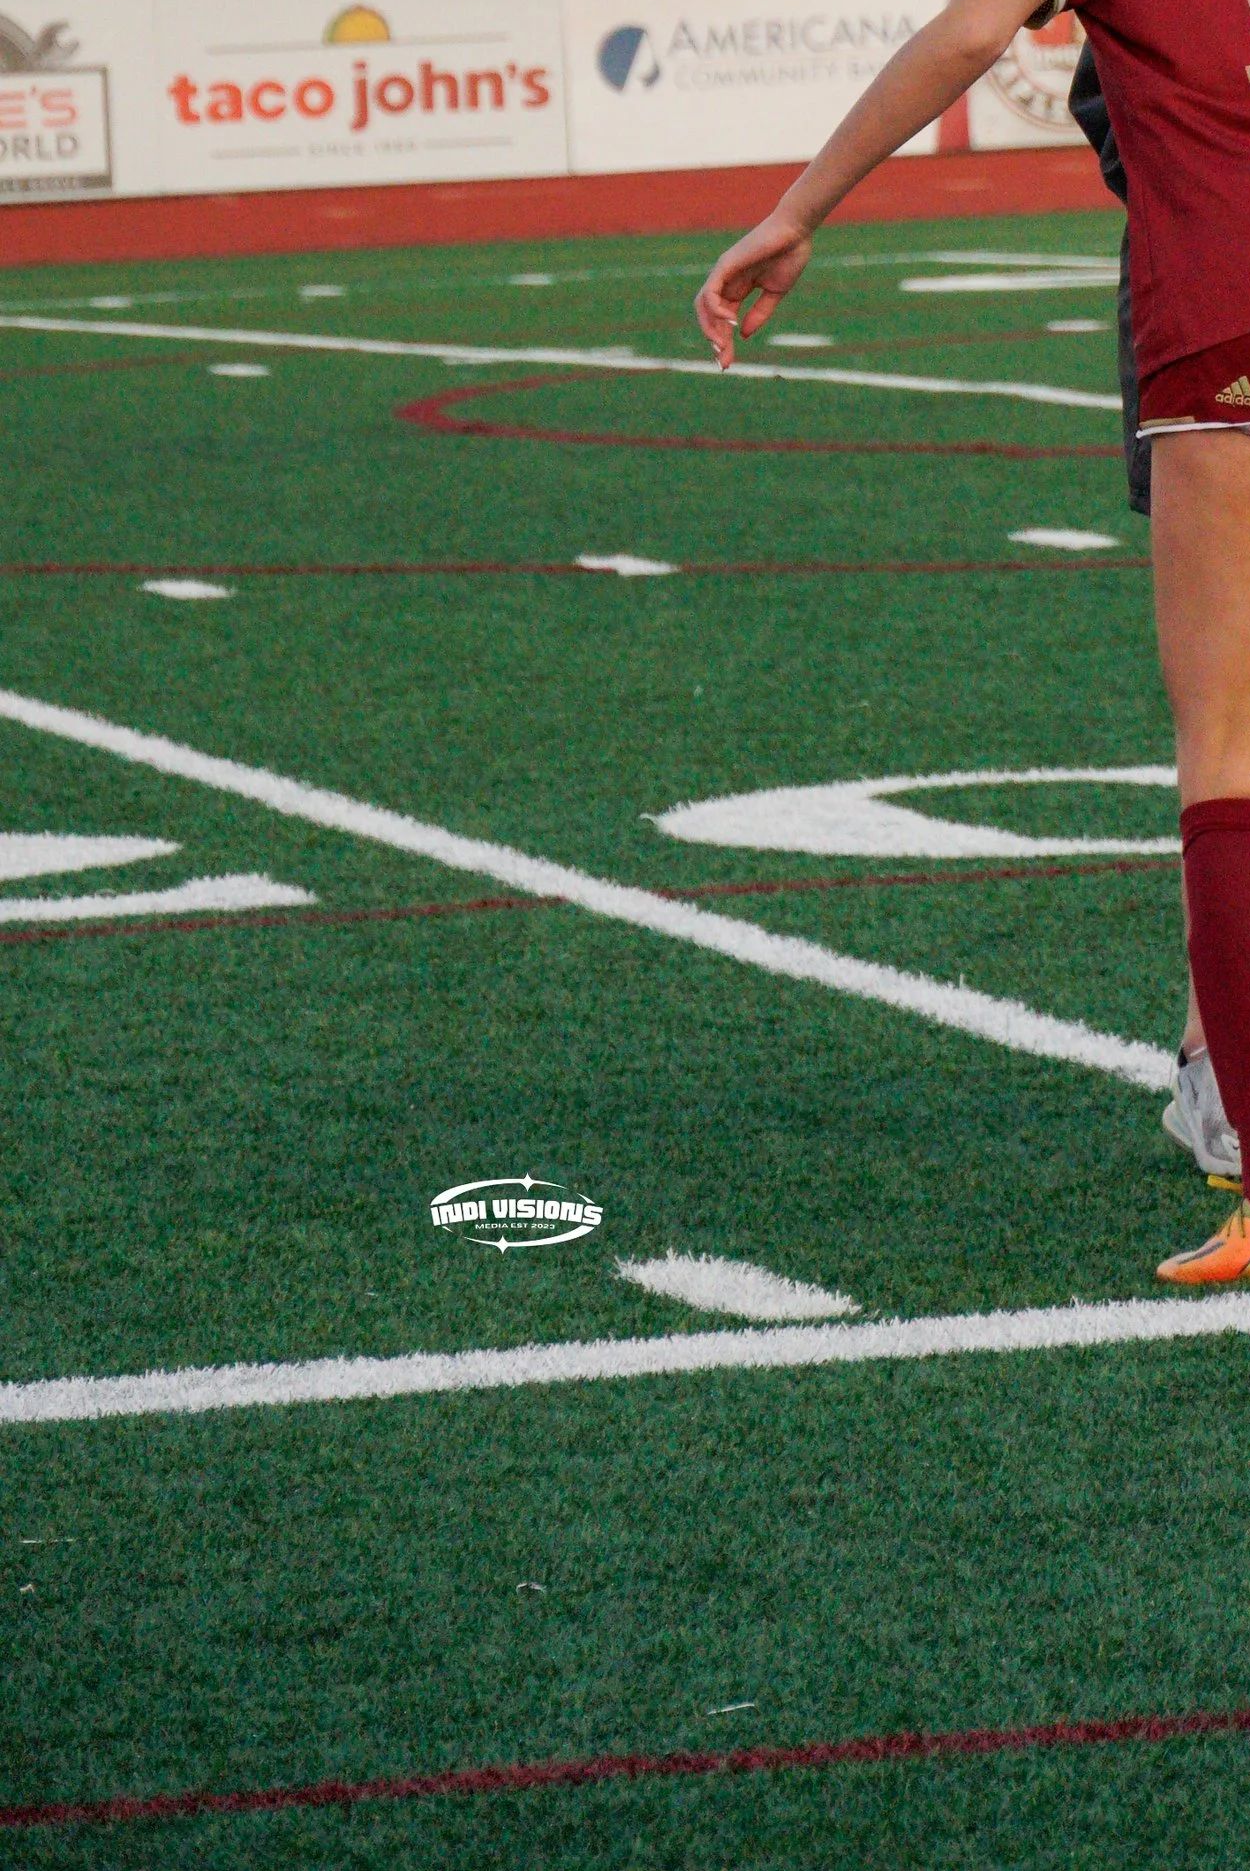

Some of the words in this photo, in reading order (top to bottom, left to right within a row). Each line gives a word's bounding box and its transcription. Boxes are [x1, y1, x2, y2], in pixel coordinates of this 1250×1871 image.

[667, 14, 916, 58] AMERICANA
[168, 73, 335, 126] taco
[350, 60, 550, 132] john's
[673, 60, 837, 91] COMMUNITY
